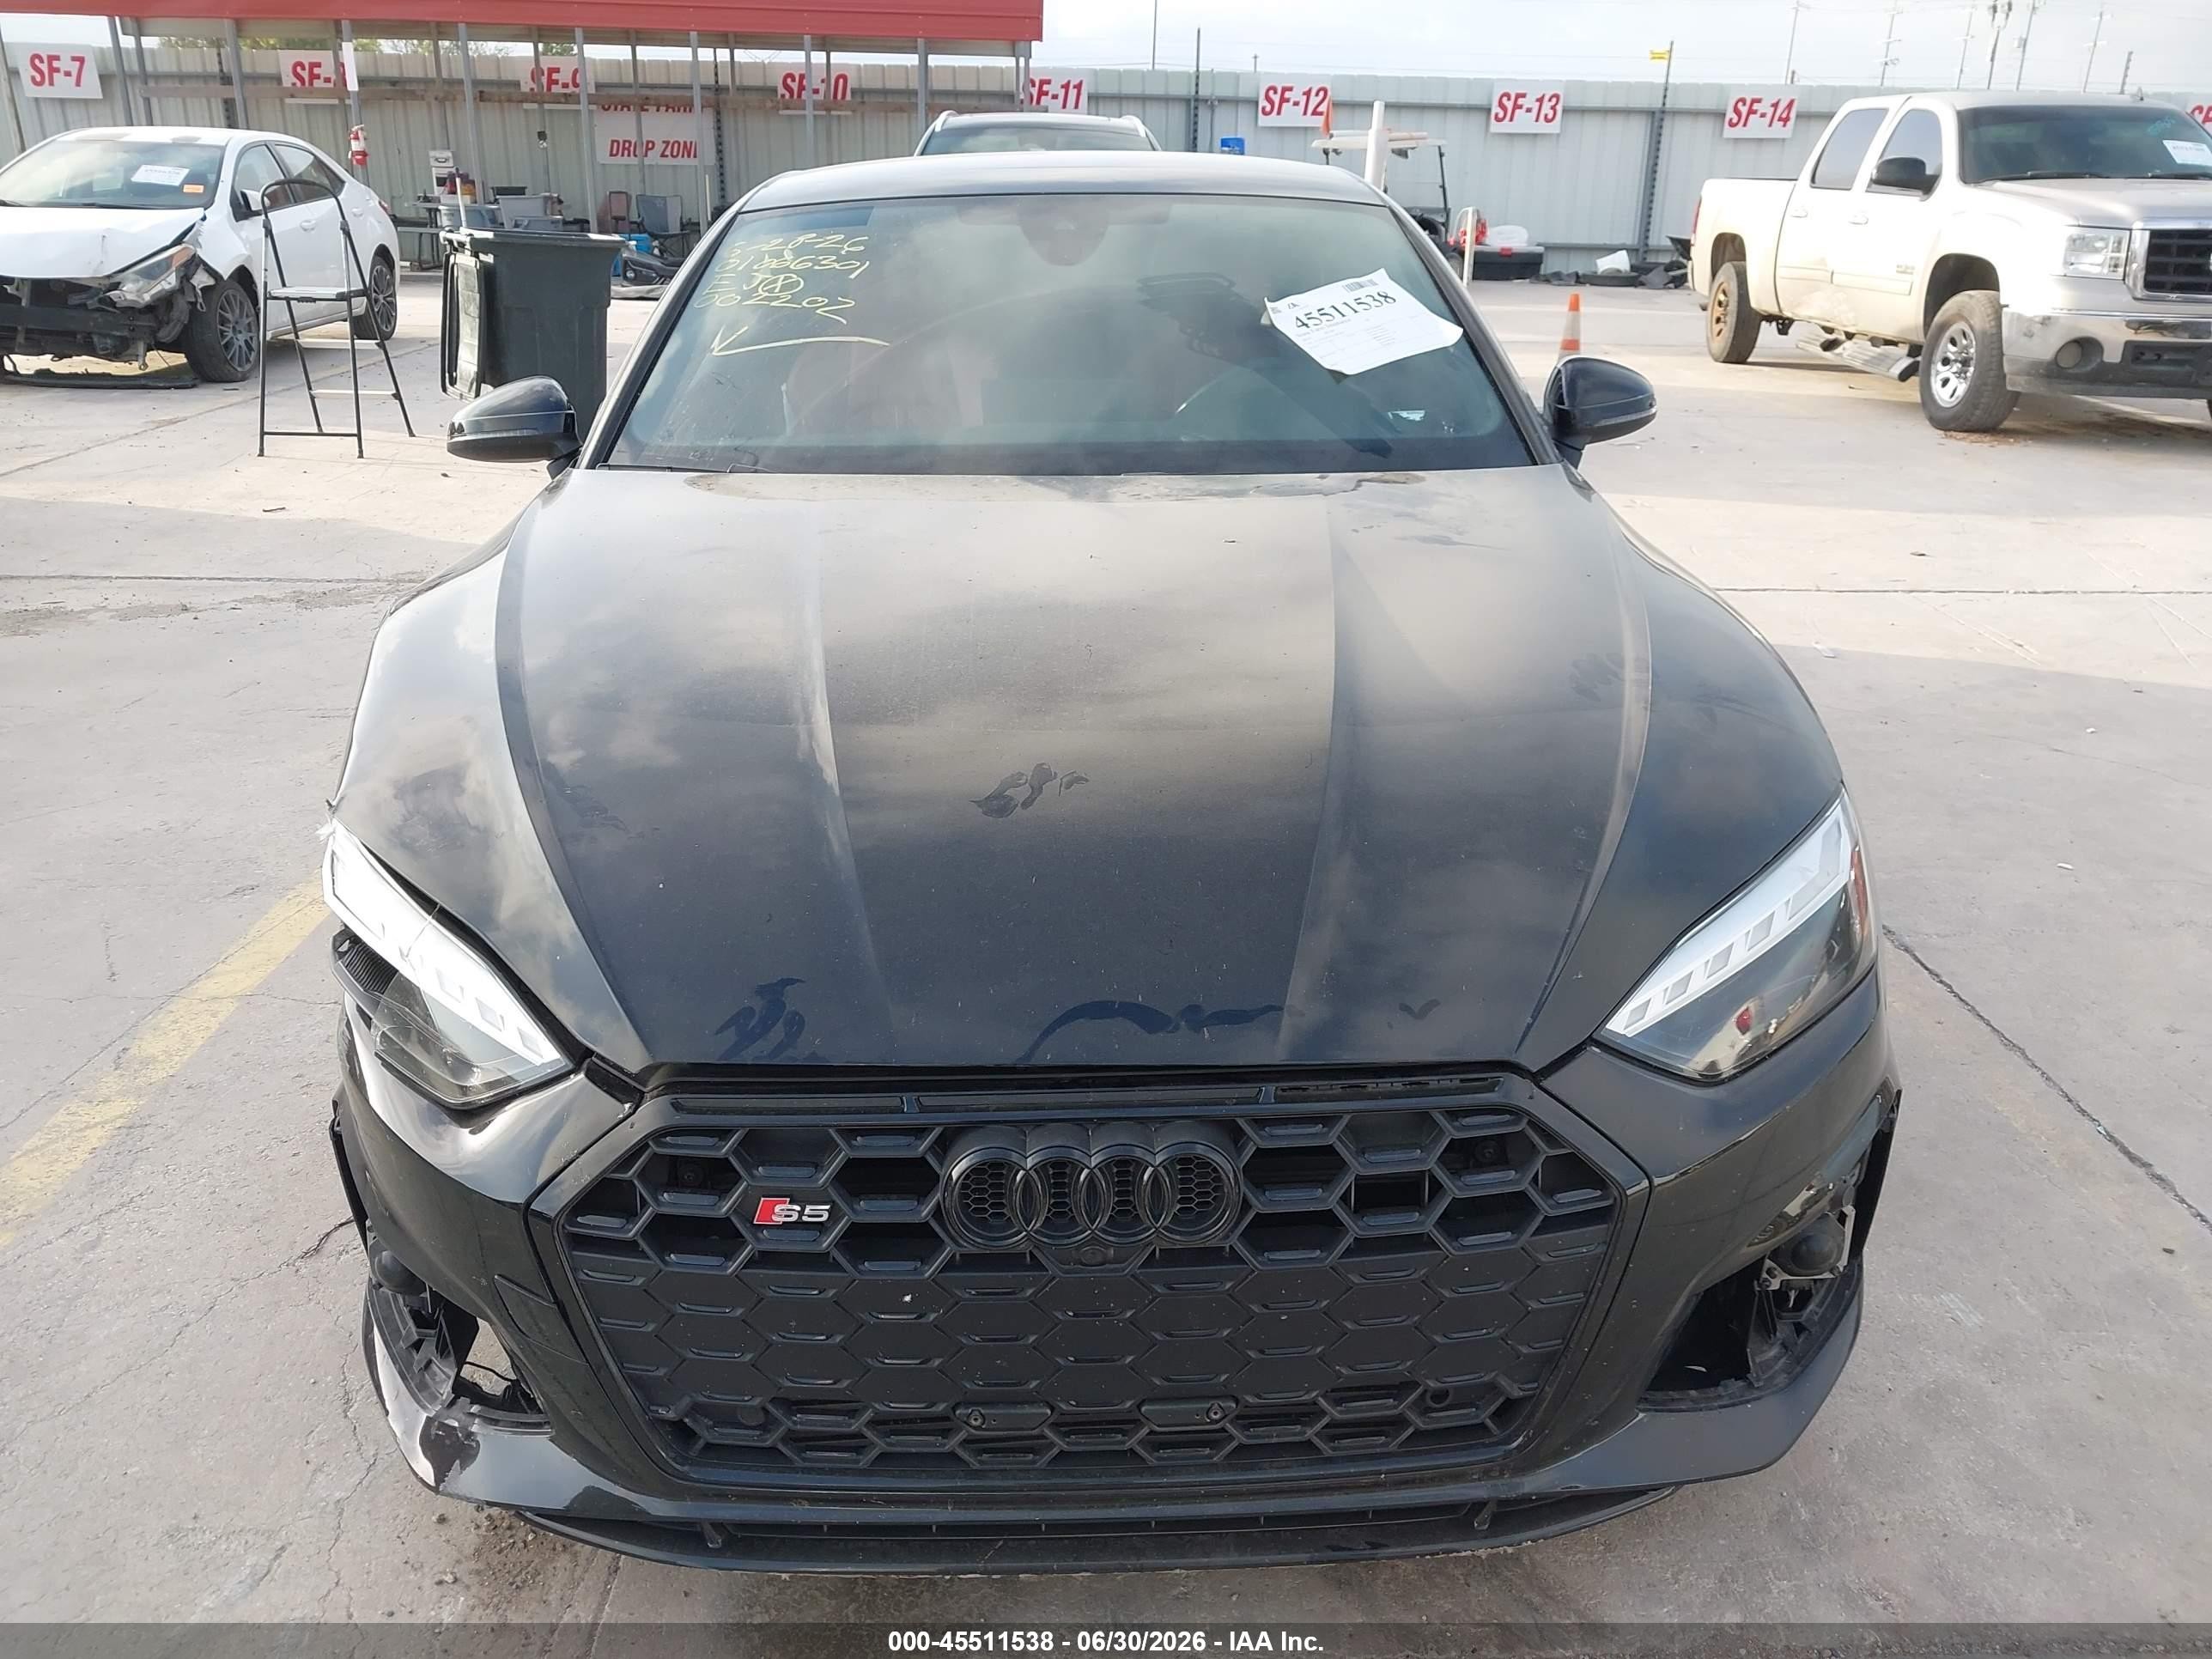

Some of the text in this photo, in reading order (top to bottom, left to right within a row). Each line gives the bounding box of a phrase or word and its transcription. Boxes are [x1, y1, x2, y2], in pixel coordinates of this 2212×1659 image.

[29, 53, 86, 87] SF-7
[781, 73, 848, 100] SF-0
[1261, 85, 1328, 116] SF-12
[1494, 92, 1560, 123] SF-13
[1728, 97, 1796, 128] SF-14
[1295, 290, 1397, 329] 45511538
[771, 1204, 831, 1222] S5
